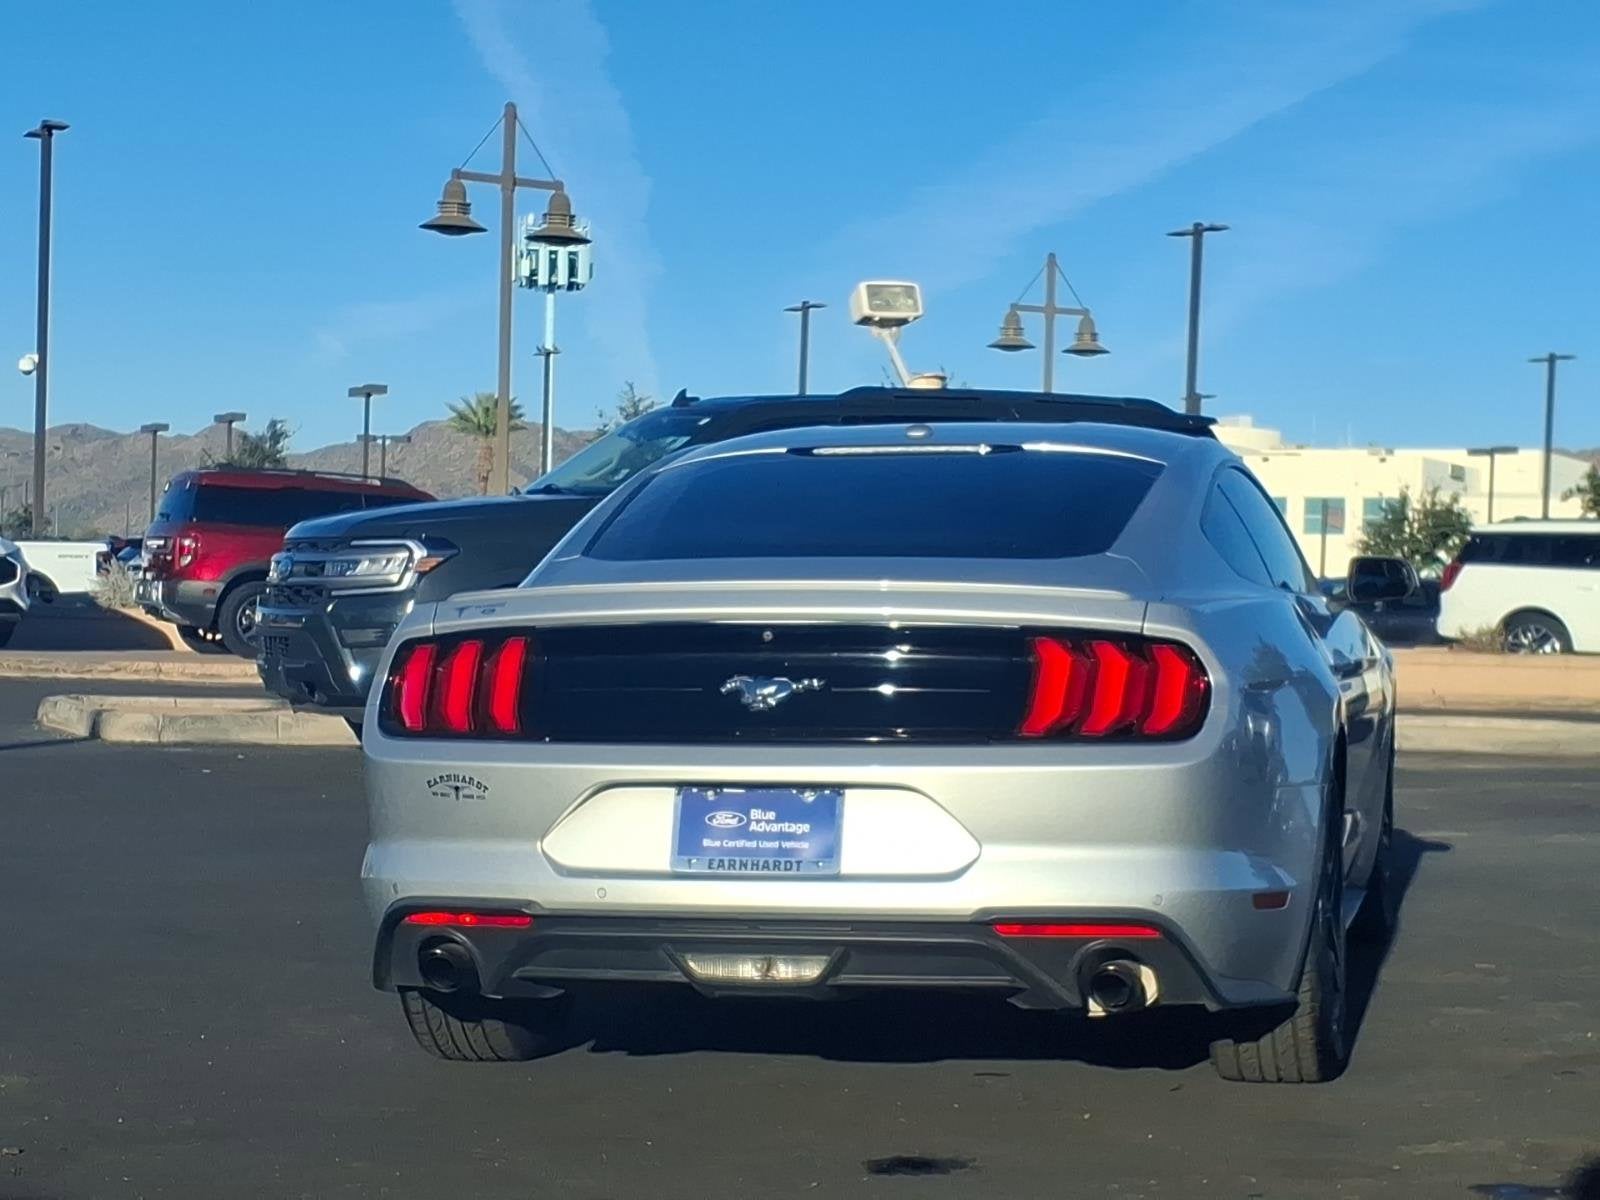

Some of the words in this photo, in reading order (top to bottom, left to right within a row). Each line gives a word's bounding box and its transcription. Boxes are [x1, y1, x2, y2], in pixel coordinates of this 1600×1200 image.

[426, 773, 489, 793] EARNHARDT
[750, 808, 776, 820] Blue
[749, 821, 811, 834] Advantage
[703, 838, 721, 847] Blue
[723, 839, 757, 848] Certified
[759, 840, 779, 848] Used
[707, 858, 803, 872] EARNHARDT
